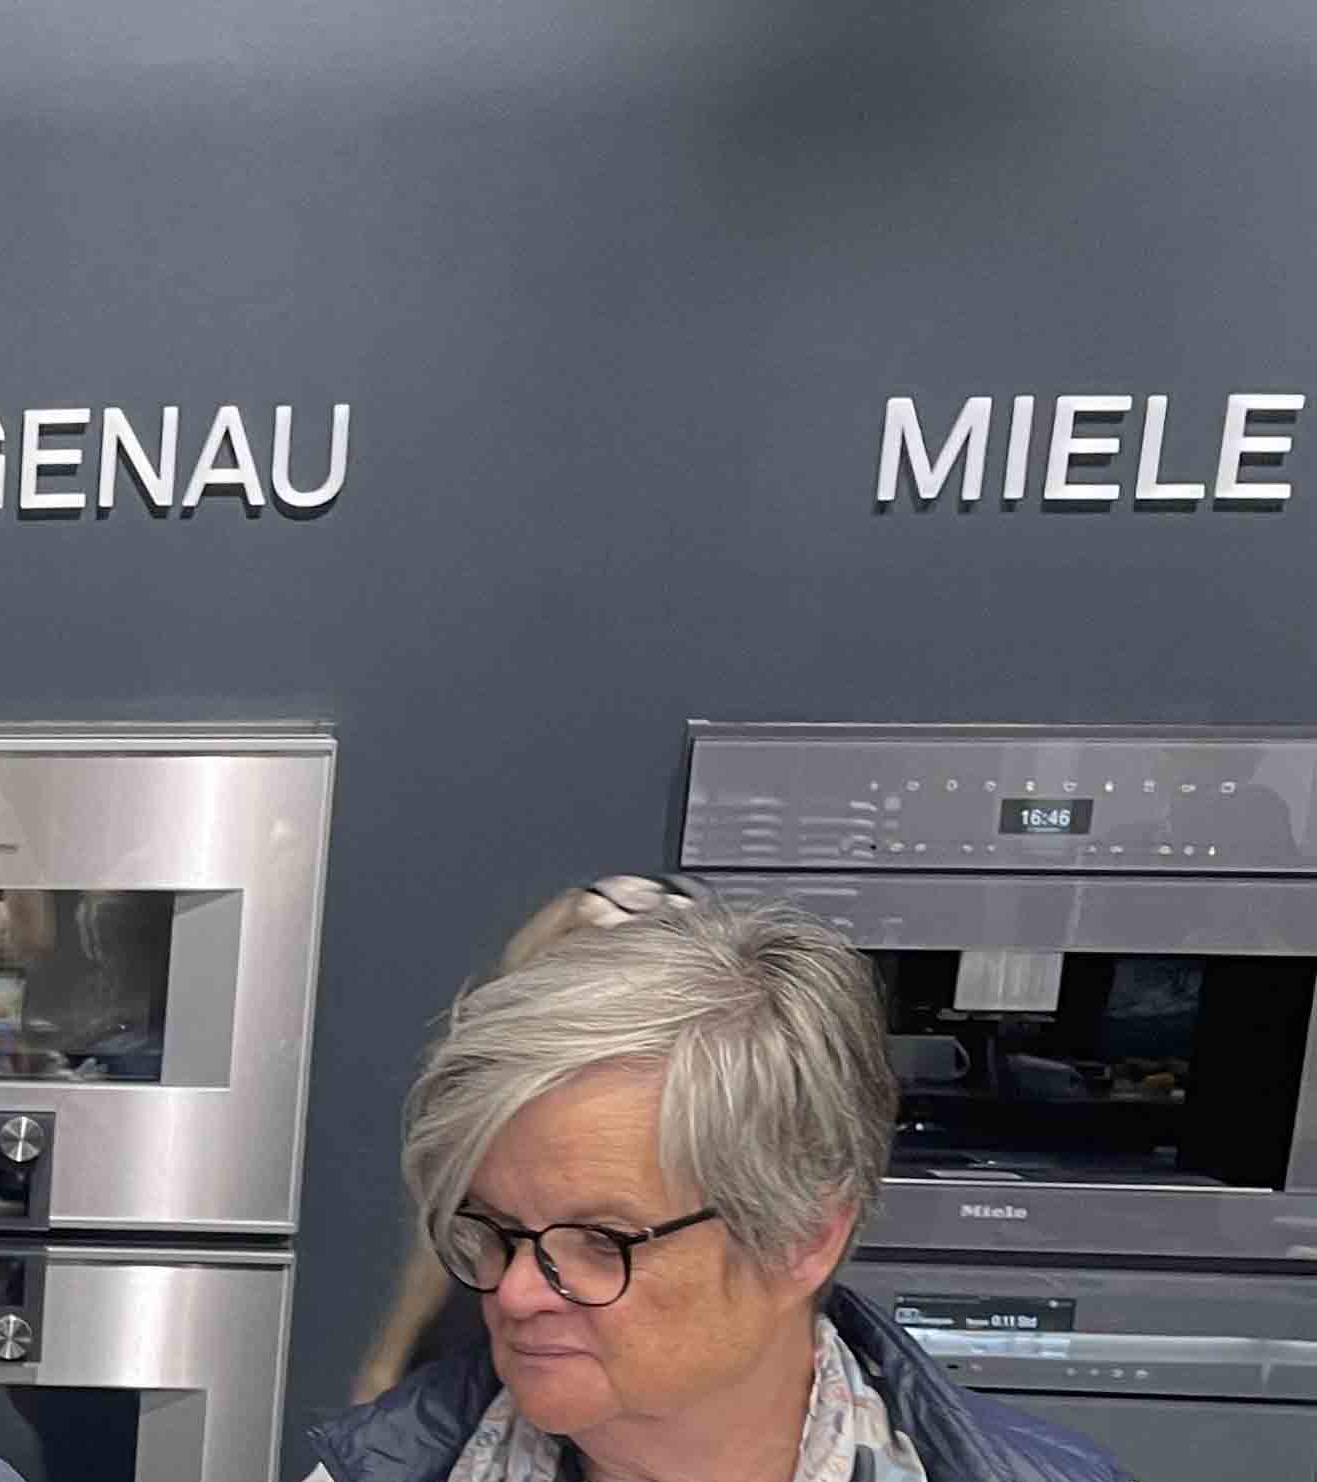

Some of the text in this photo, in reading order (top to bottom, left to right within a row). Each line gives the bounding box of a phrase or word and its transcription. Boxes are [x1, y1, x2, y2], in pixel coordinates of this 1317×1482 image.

[876, 393, 1307, 507] MIELE
[1021, 809, 1071, 826] 16:46
[960, 1203, 1028, 1220] Miele
